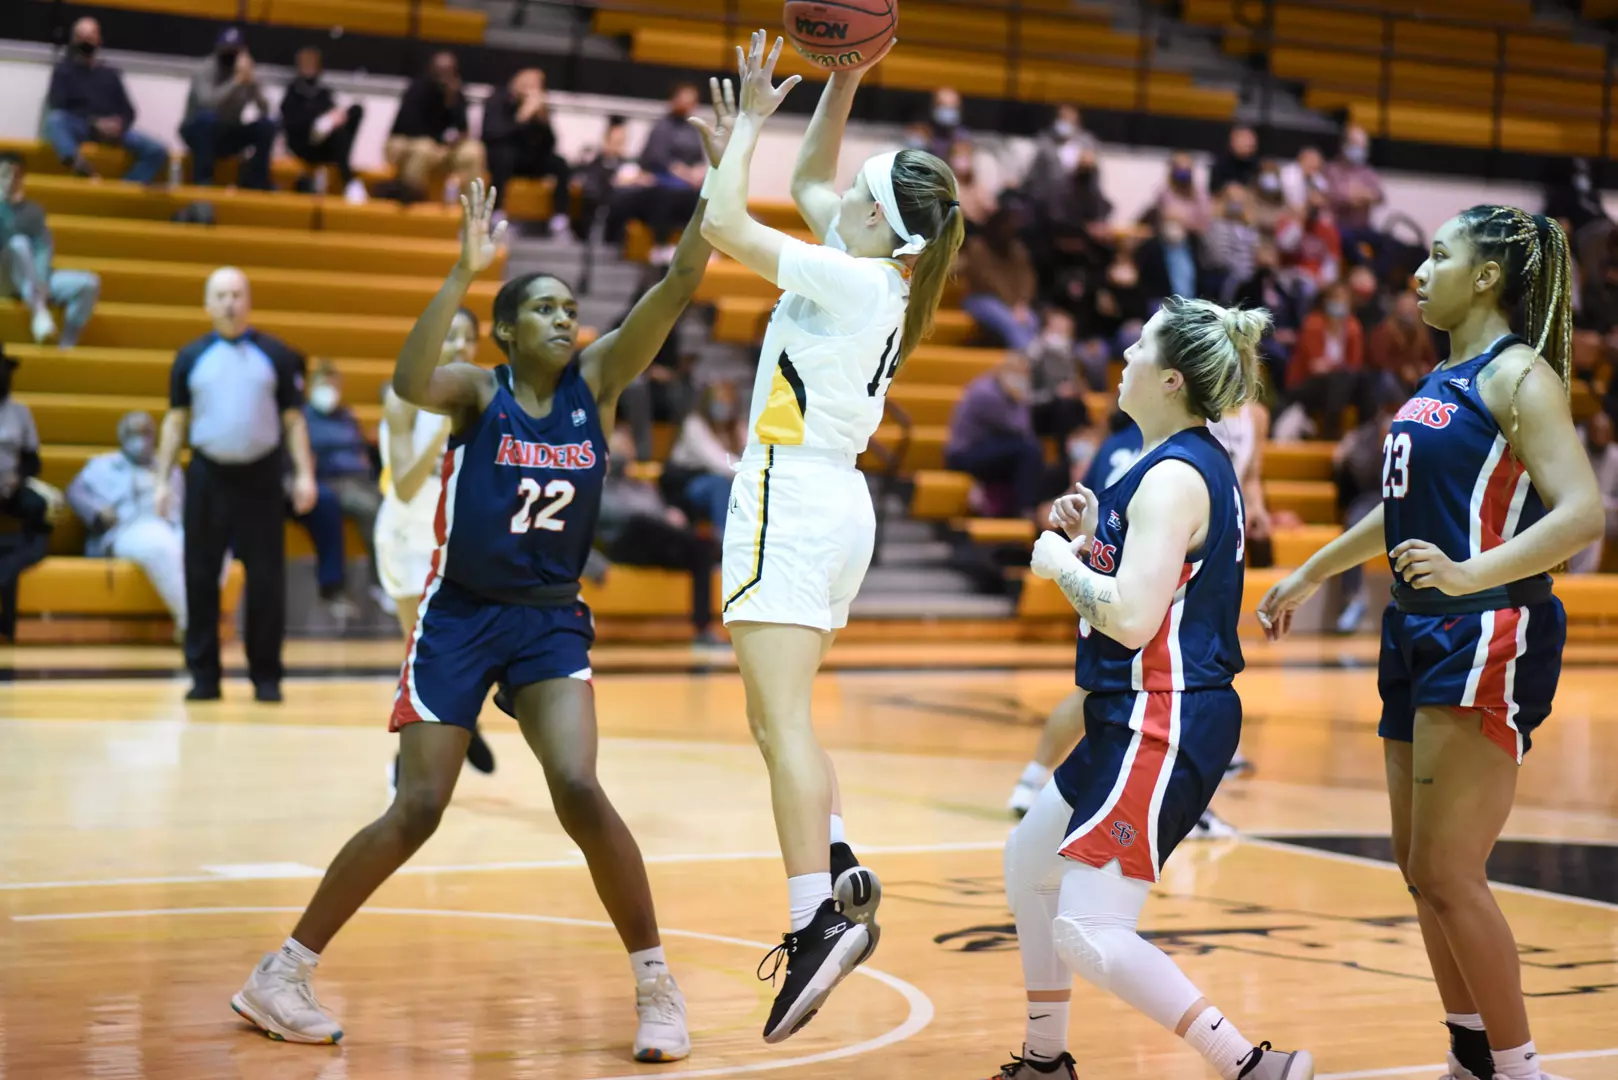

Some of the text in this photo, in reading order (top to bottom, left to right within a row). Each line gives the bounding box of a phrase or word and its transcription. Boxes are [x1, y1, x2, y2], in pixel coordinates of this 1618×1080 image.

[796, 16, 849, 40] NCAA
[494, 433, 596, 470] RAIDERS
[1382, 432, 1412, 498] 23
[510, 477, 575, 534] 22
